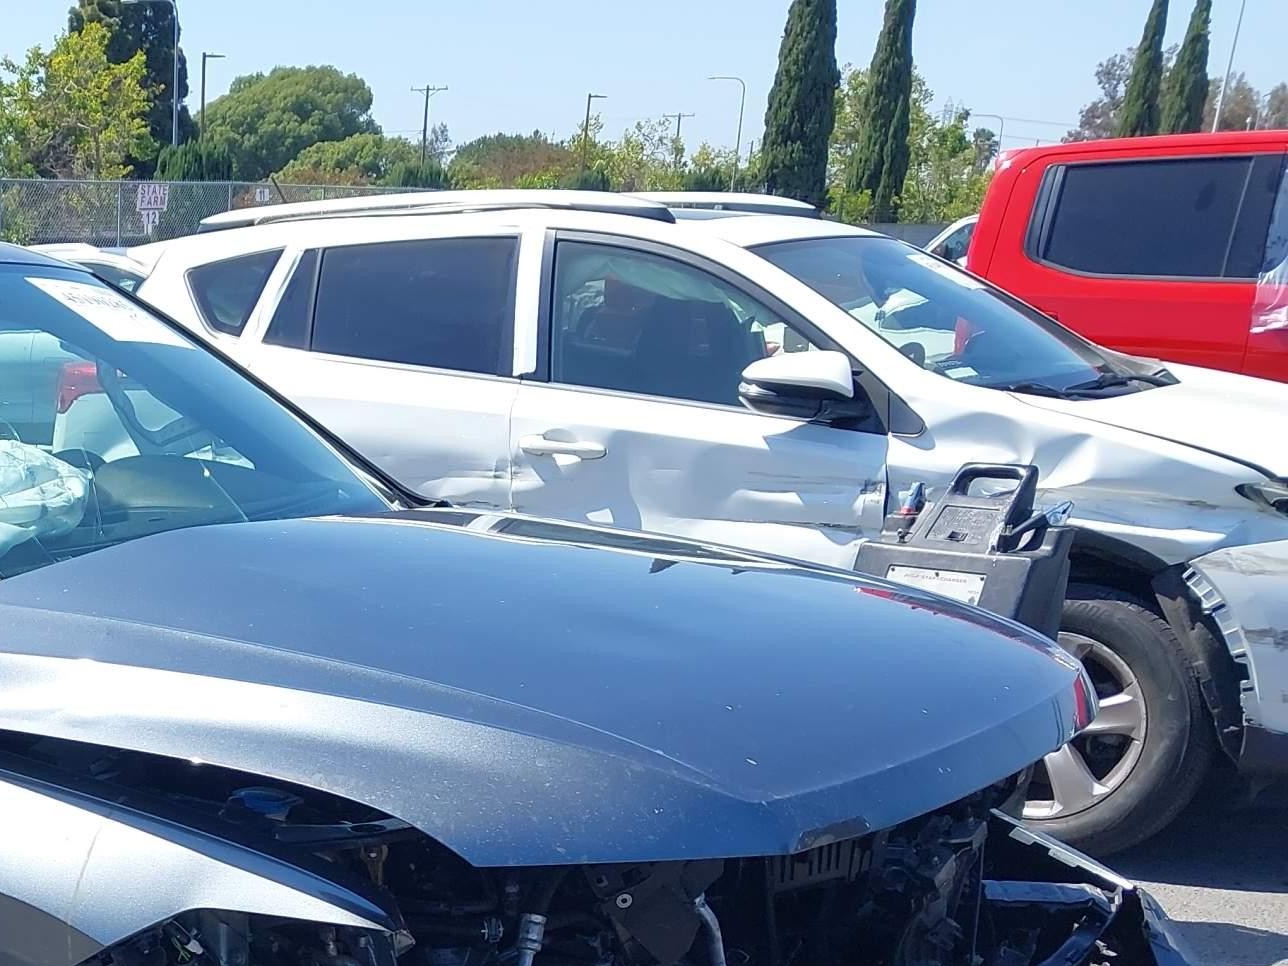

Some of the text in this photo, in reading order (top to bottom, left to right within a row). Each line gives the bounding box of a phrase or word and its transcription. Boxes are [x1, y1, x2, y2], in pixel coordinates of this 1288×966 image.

[140, 184, 168, 196] STATE
[140, 195, 166, 207] FARM
[145, 211, 158, 225] 12
